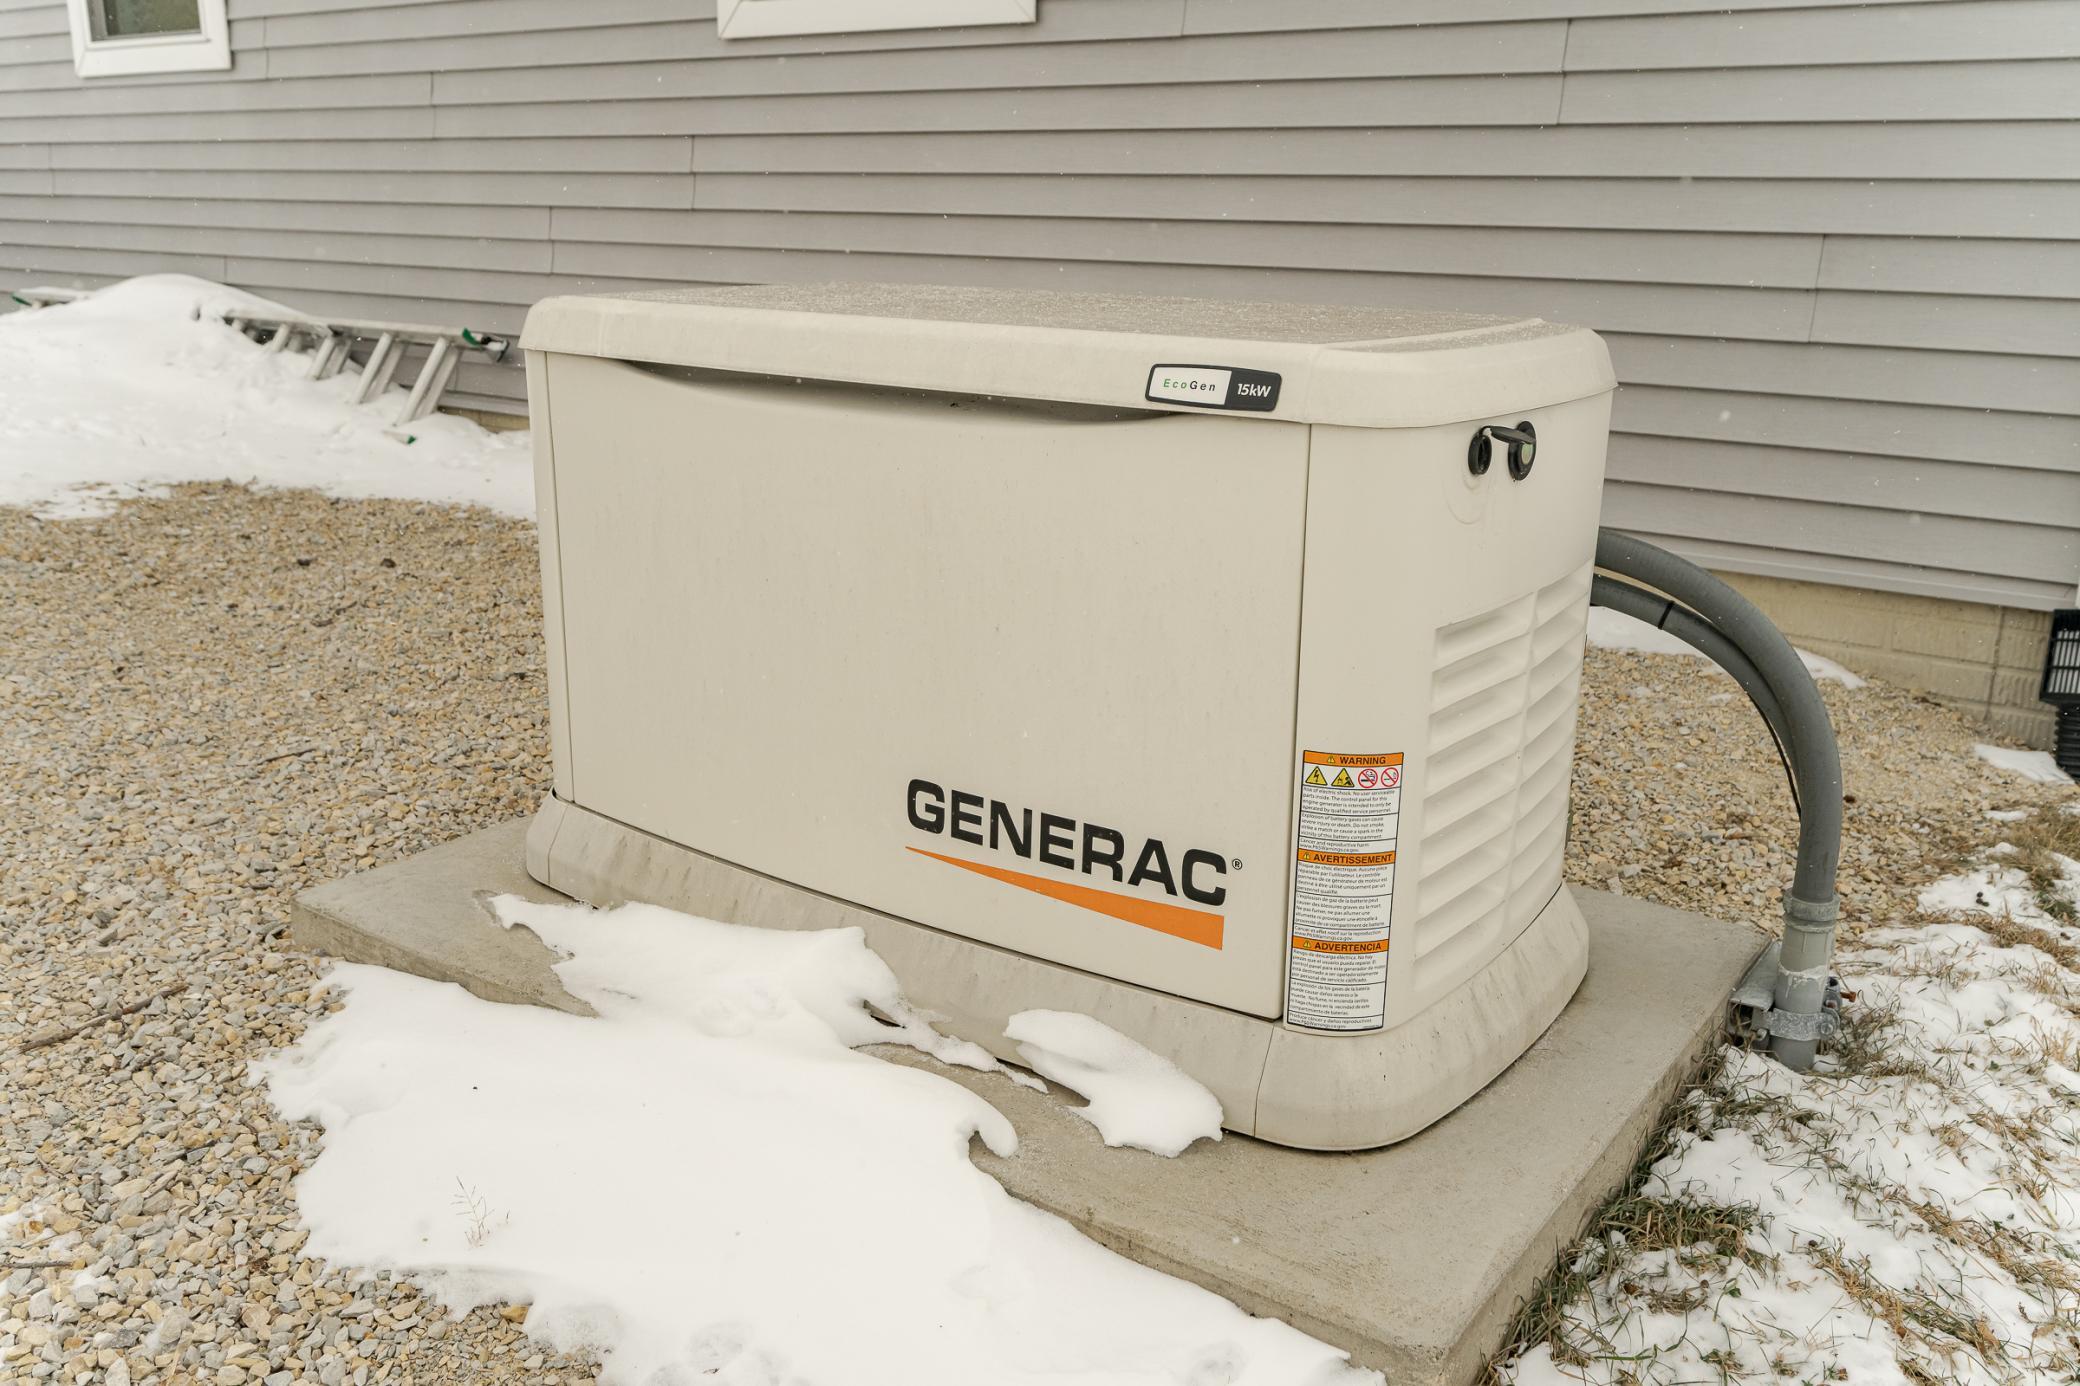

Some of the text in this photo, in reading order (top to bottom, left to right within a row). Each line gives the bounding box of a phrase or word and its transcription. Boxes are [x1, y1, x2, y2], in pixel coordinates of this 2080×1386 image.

[1163, 378, 1271, 398] EcoGen 15kW
[1340, 756, 1386, 765] WARNING
[1313, 853, 1392, 864] AVERTISSEMENT
[1314, 942, 1381, 952] ADVERTENCIA
